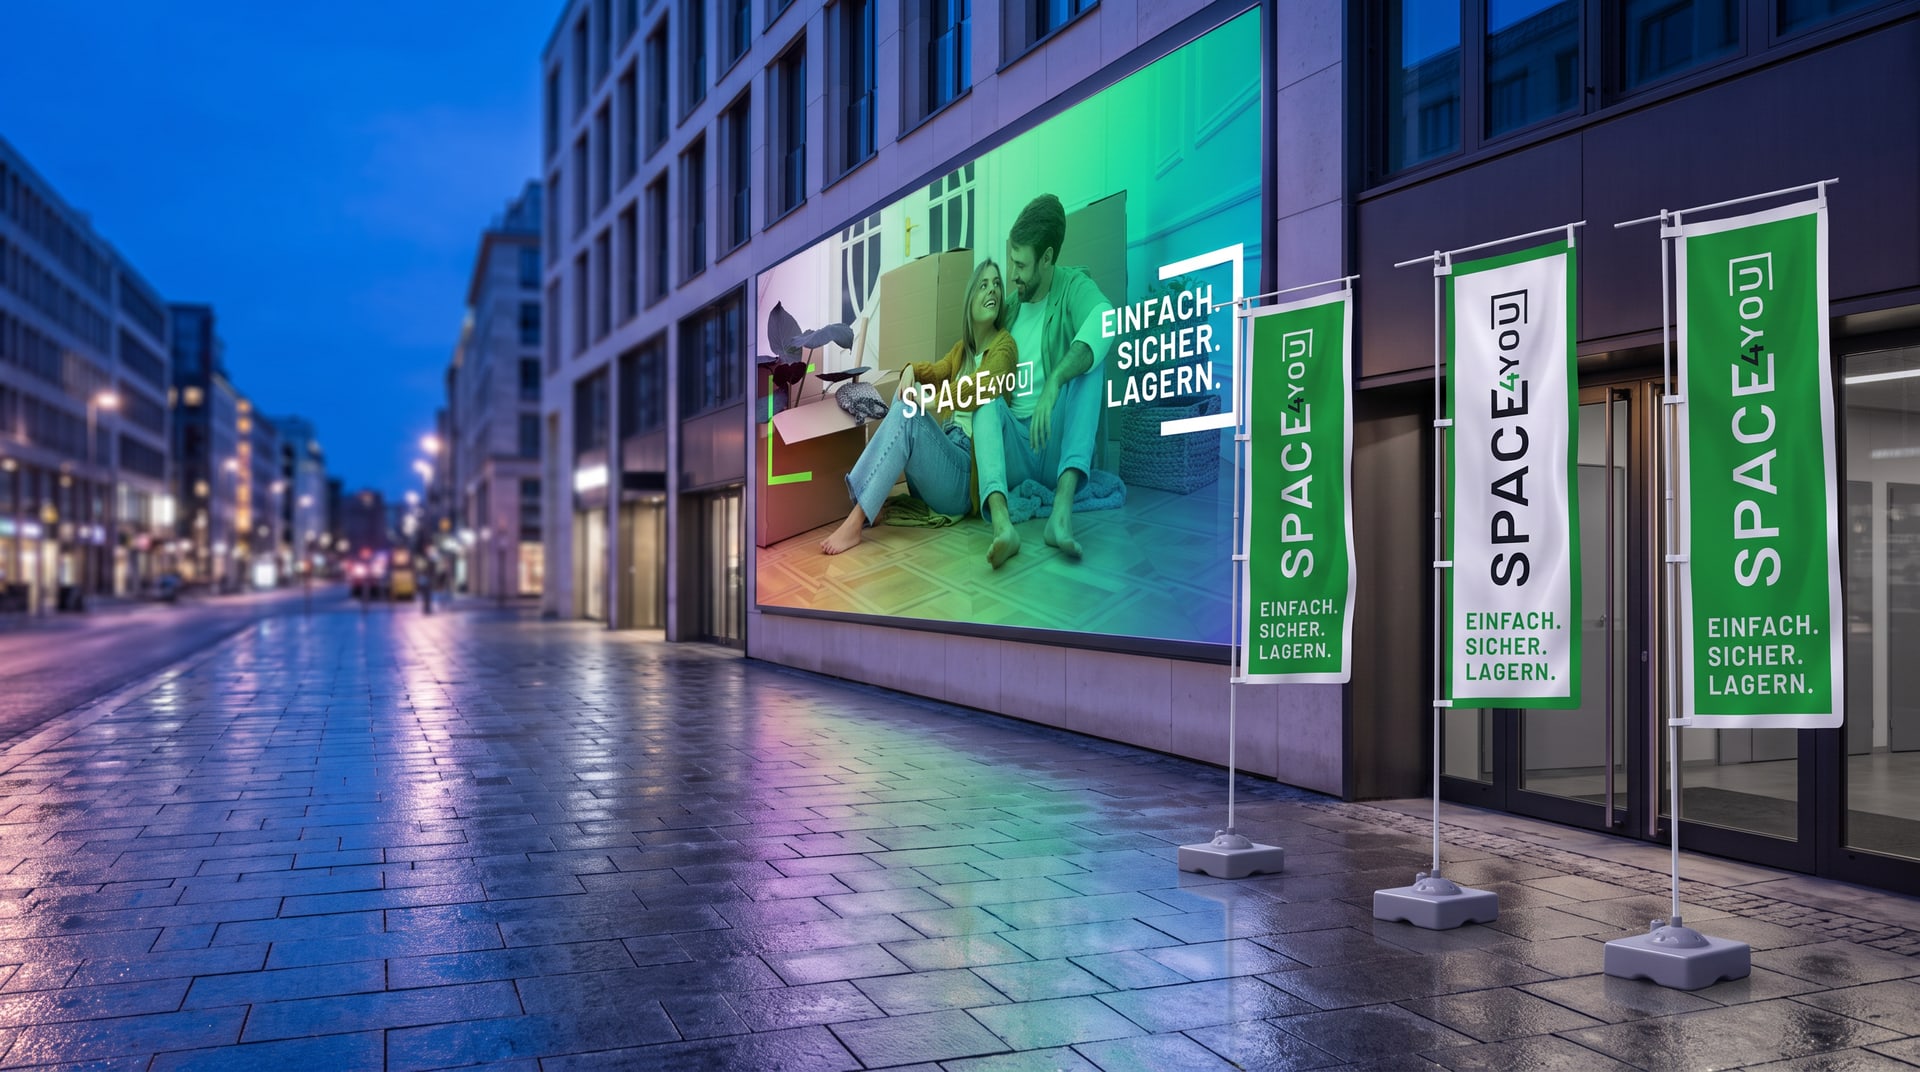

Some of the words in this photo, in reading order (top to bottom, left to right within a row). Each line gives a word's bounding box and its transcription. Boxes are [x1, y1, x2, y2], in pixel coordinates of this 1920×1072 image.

[1101, 284, 1220, 338] EINFACH.
[1117, 324, 1220, 370] SICHER.
[902, 368, 1028, 418] SPACE4YOU
[1107, 361, 1221, 408] LAGERN.
[1731, 266, 1781, 587] SPACE4YOU
[1490, 301, 1530, 587] SPACE4YOU
[1281, 338, 1314, 578] SPACE4YOU
[1259, 598, 1338, 617] EINFACH.
[1259, 621, 1325, 639] SICHER.
[1465, 611, 1561, 630] EINFACH.
[1708, 614, 1819, 638] EINFACH.
[1259, 642, 1331, 660] LAGERN.
[1465, 637, 1547, 656] SICHER.
[1707, 644, 1803, 667] SICHER.
[1465, 661, 1556, 681] LAGERN.
[1708, 672, 1813, 696] LAGERN.
